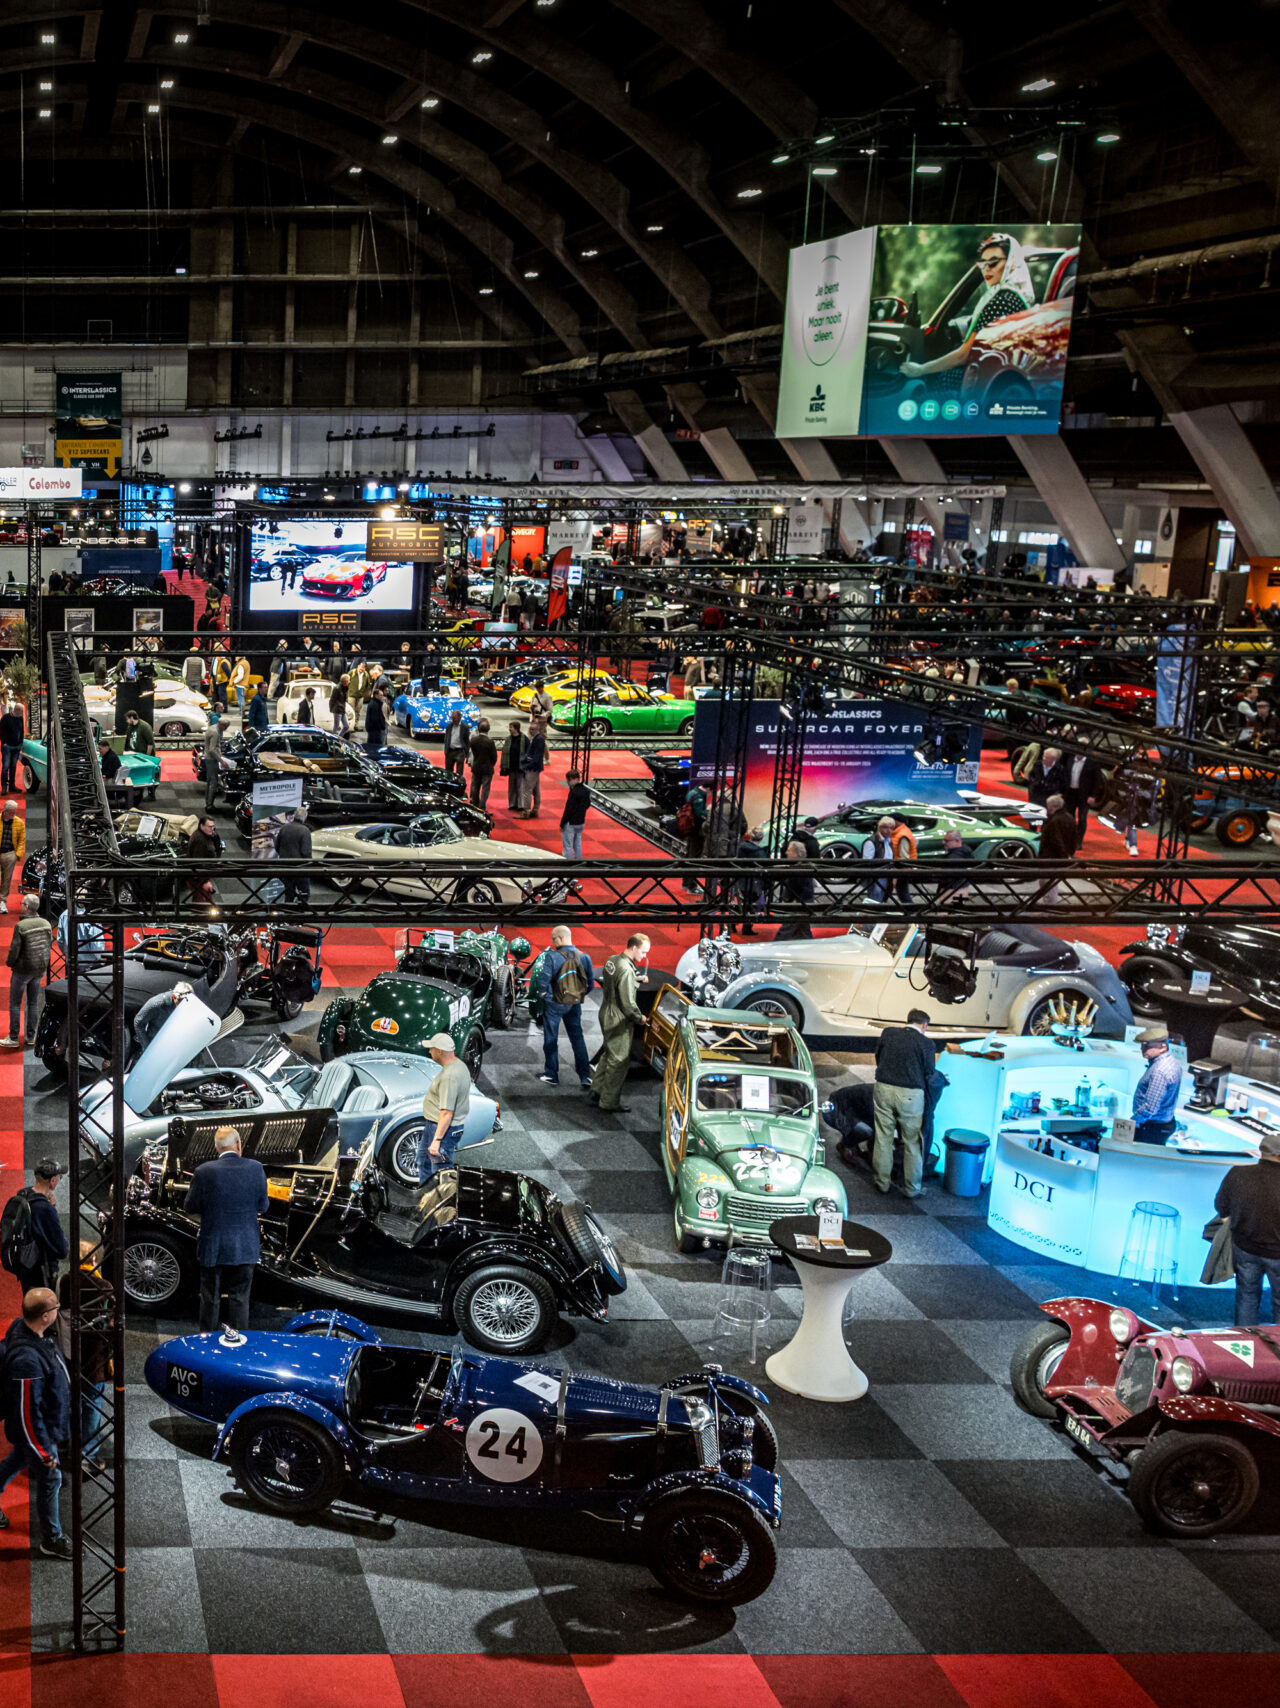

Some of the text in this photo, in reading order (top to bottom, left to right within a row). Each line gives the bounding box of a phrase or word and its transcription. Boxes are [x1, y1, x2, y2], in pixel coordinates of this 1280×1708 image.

[809, 402, 825, 412] KBC
[29, 477, 71, 490] Colombo
[372, 527, 440, 540] RSC
[303, 613, 357, 624] RSC
[864, 725, 923, 733] FOYER
[260, 783, 296, 792] METROPOLE
[1014, 1171, 1055, 1203] DCI
[824, 1217, 839, 1225] DCI
[170, 1366, 198, 1386] AVC
[177, 1382, 190, 1396] 19
[477, 1421, 527, 1464] 24
